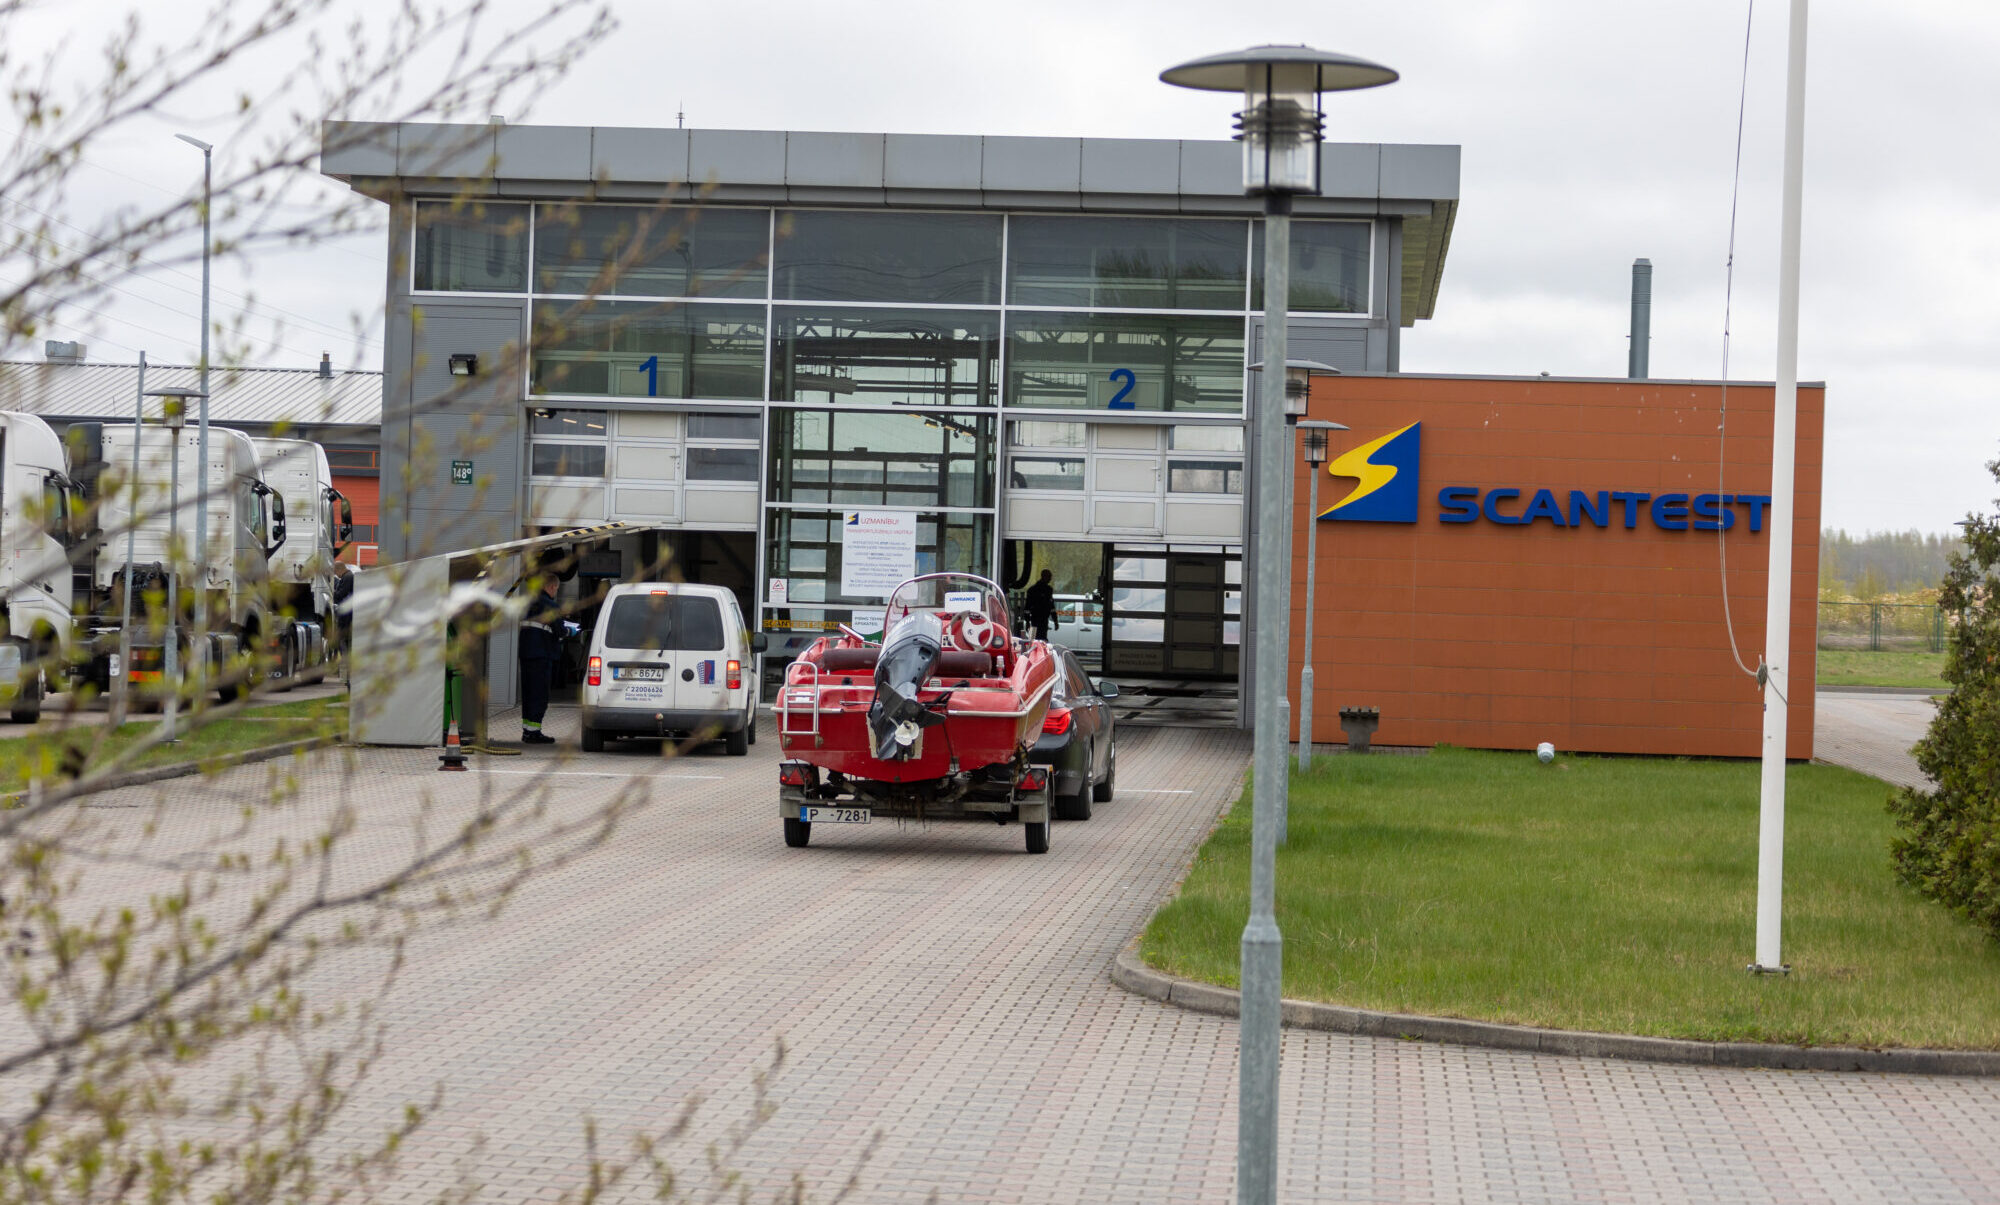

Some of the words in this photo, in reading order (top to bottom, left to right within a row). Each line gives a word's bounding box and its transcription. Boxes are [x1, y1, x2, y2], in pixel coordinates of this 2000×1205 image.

[639, 356, 658, 397] 1
[1108, 369, 1136, 409] 2
[1438, 487, 1771, 531] SCANTEST
